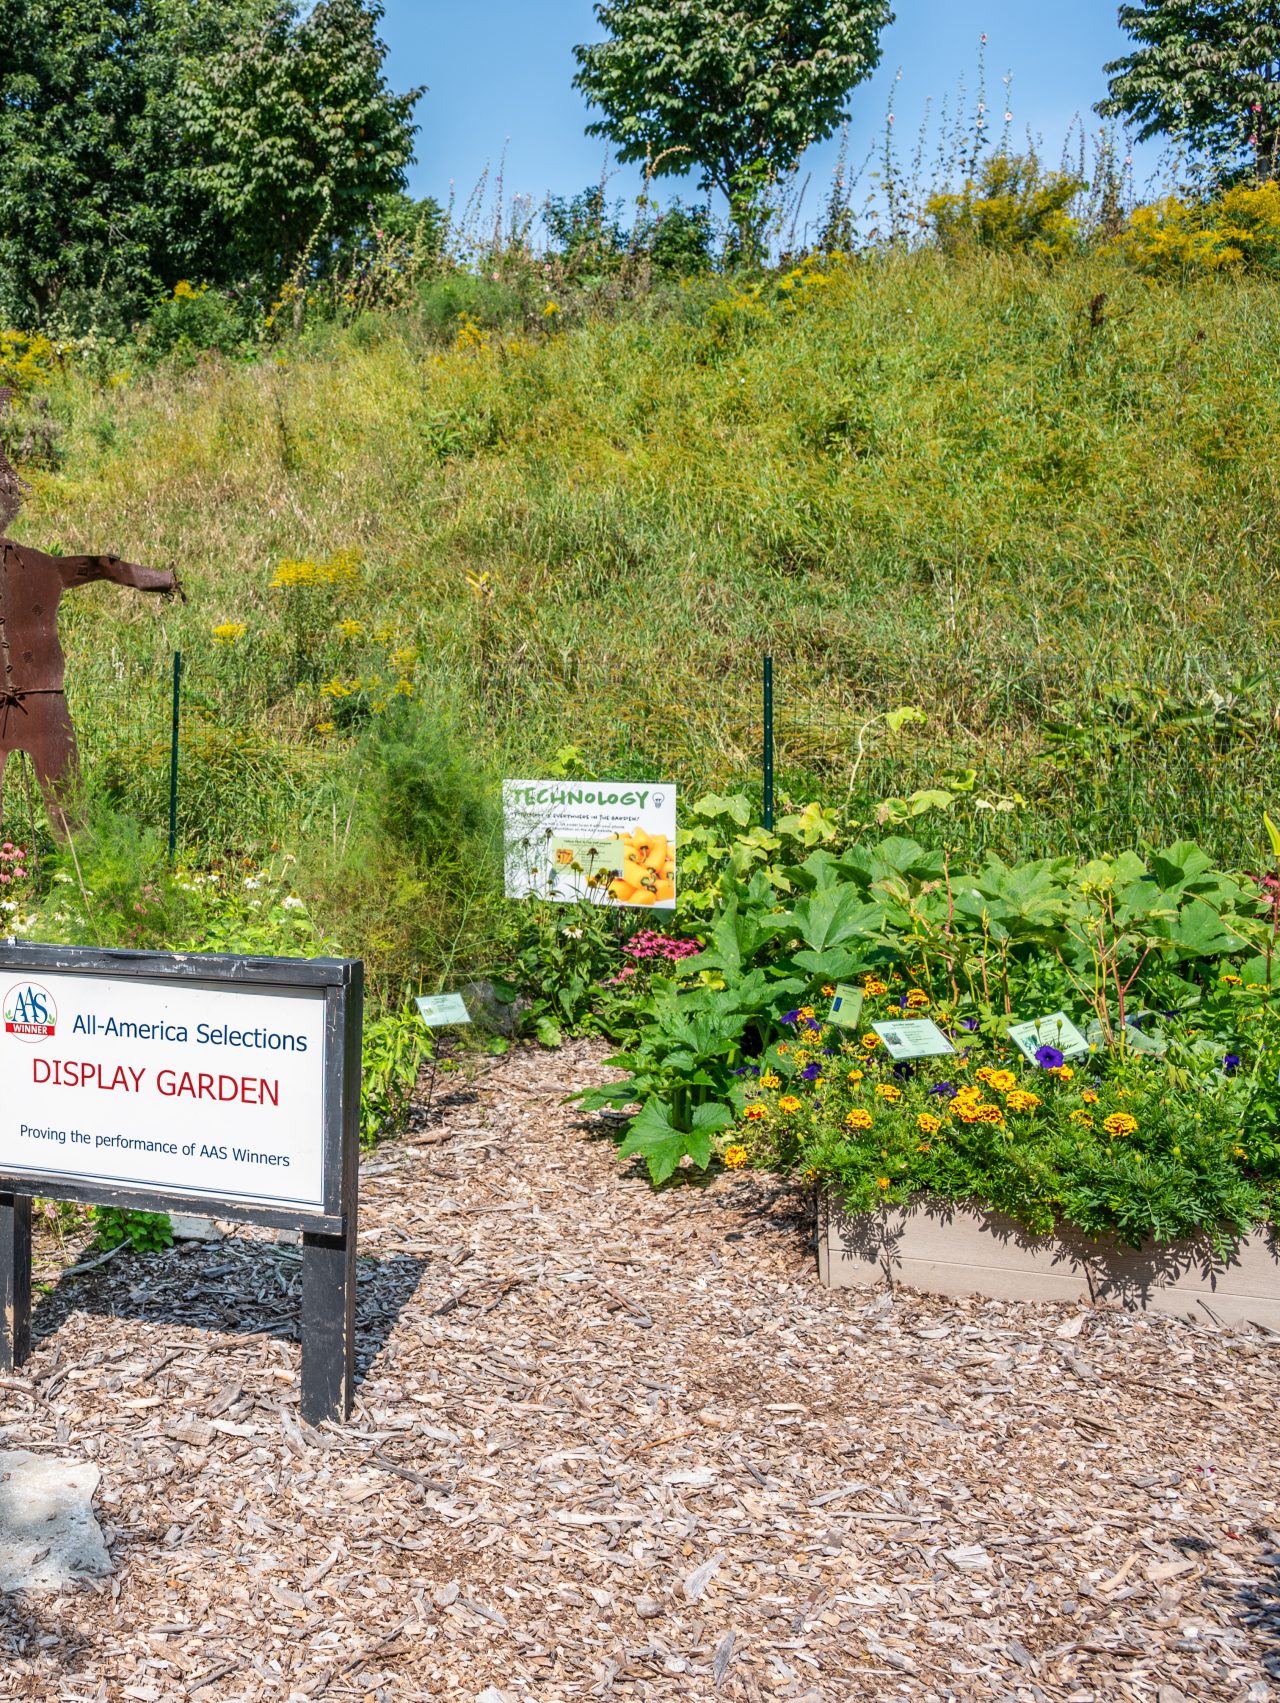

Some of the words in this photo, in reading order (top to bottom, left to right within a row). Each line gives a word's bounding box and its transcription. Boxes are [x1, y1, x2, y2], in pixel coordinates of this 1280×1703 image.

[512, 787, 649, 809] TECHNOLOGY
[11, 986, 48, 1024] AAS
[13, 1023, 48, 1034] WINNER
[73, 1015, 187, 1042] All-America
[197, 1024, 307, 1051] Selections
[34, 1059, 145, 1092] DISPLAY
[157, 1070, 278, 1106] GARDEN
[21, 1125, 65, 1144] Proving
[71, 1130, 90, 1144] the
[96, 1135, 177, 1154] performance
[182, 1143, 196, 1156] of
[200, 1145, 227, 1159] AAS
[233, 1148, 289, 1166] Winners
